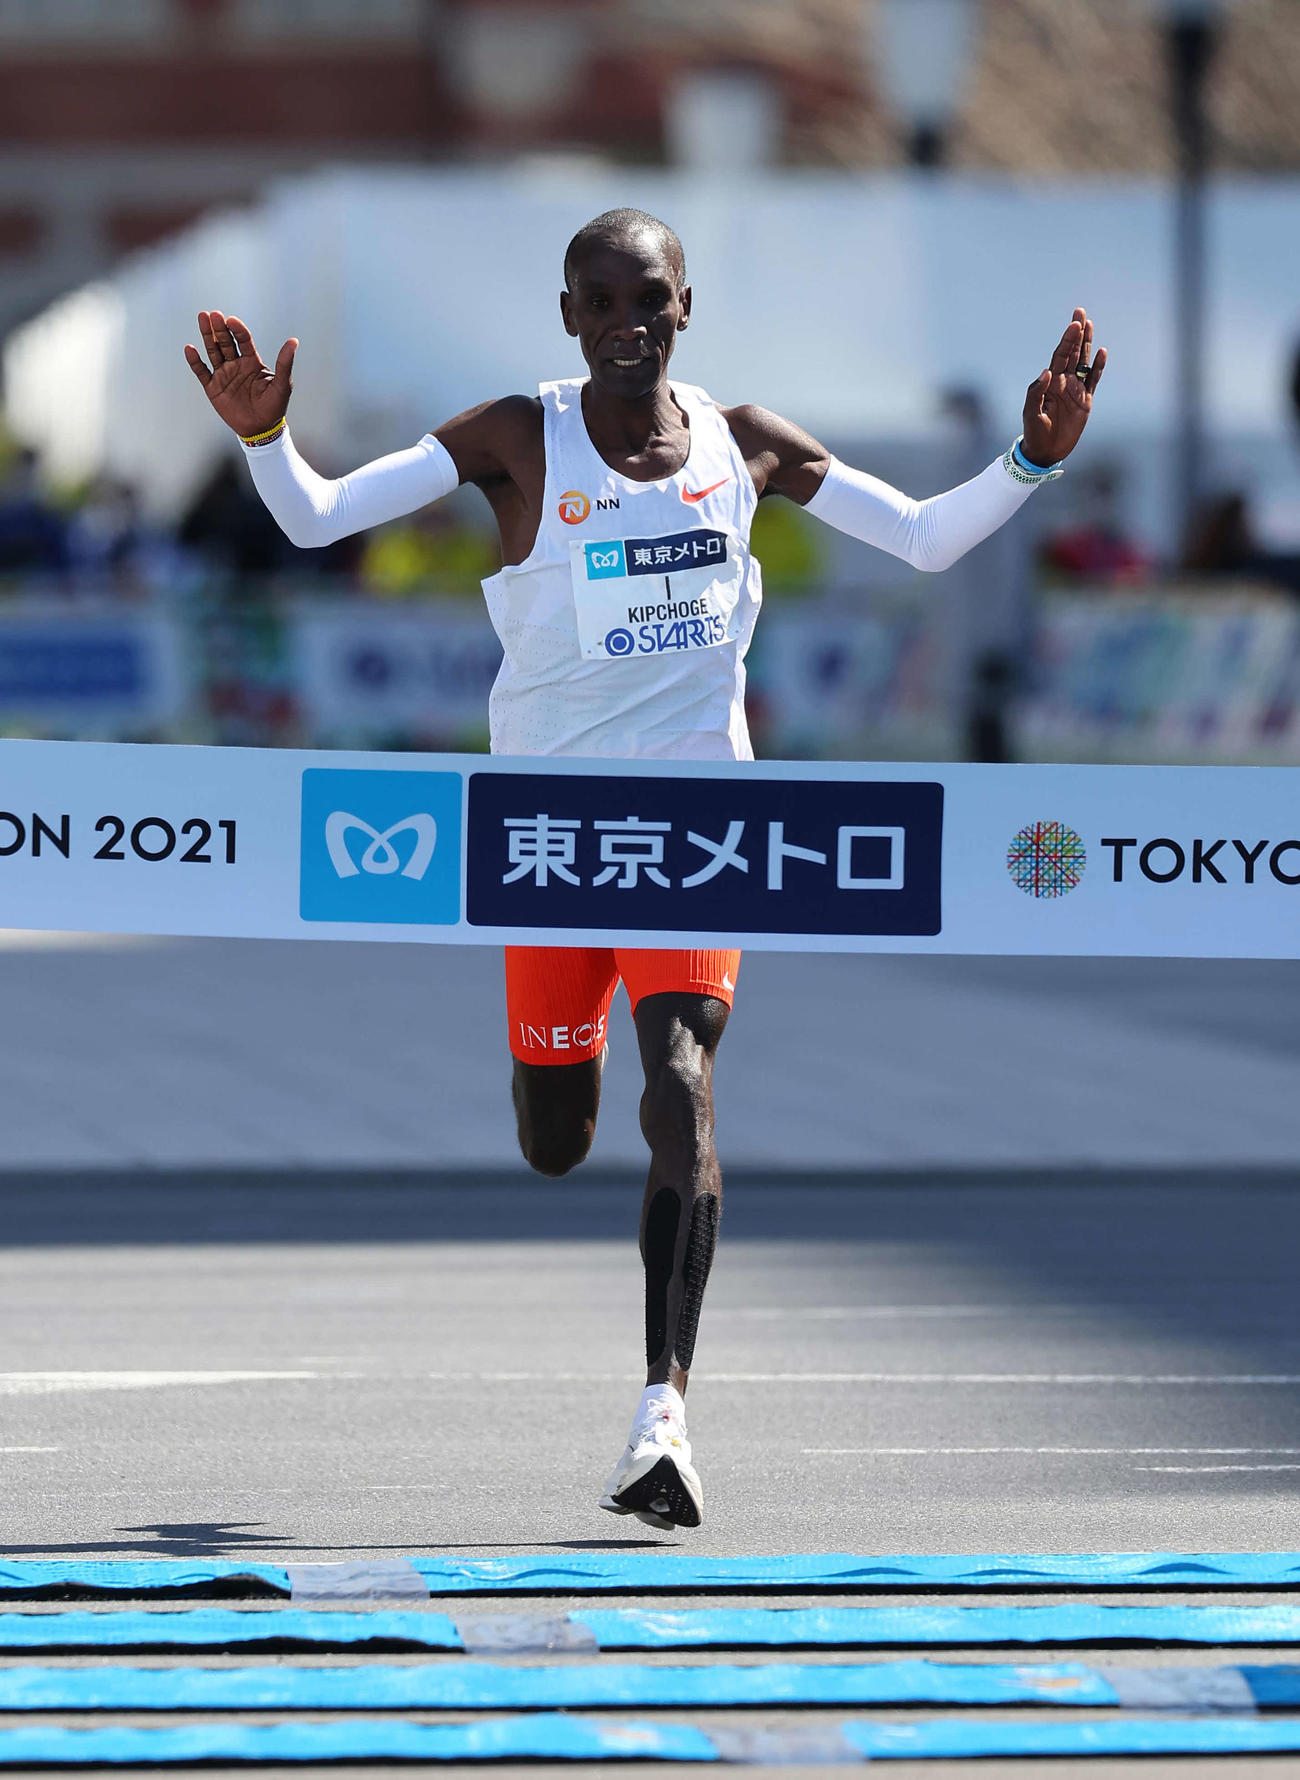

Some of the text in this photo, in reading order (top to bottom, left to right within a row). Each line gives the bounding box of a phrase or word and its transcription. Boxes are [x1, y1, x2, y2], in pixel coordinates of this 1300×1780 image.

[596, 498, 620, 511] NN
[633, 537, 721, 567] 東京メトロ
[627, 598, 709, 624] KIPCHOGE
[93, 815, 237, 865] 2021
[502, 813, 905, 890] 東京メトロ
[1101, 837, 1300, 885] TOKYO
[519, 1014, 607, 1049] INEOS
